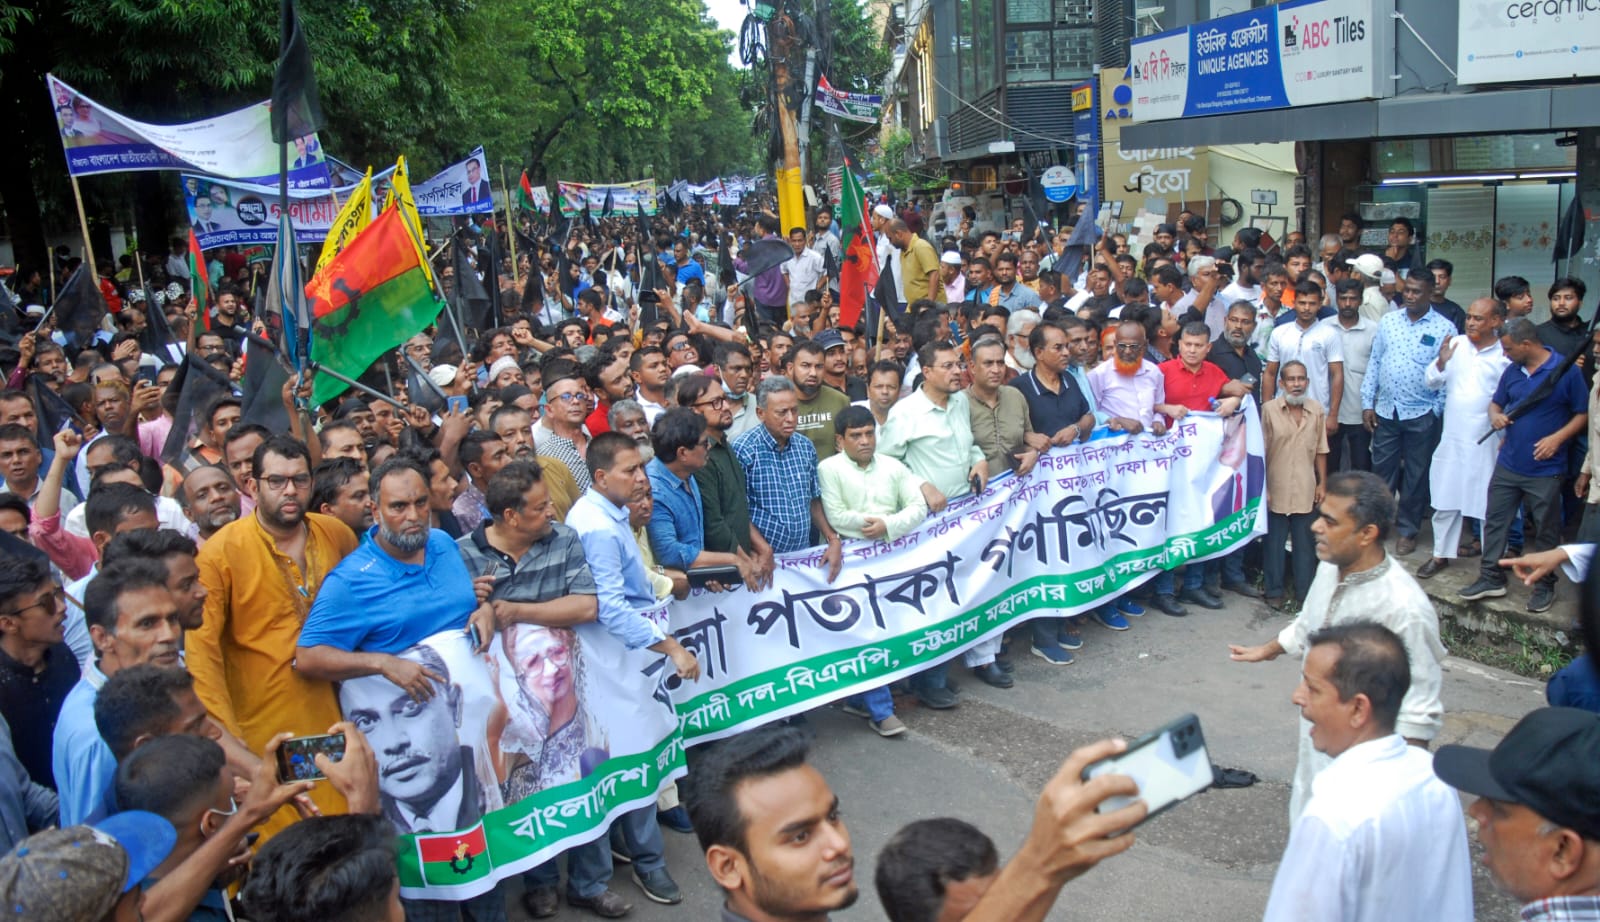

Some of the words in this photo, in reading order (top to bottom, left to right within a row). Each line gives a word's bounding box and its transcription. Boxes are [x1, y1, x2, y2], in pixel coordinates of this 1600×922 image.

[1196, 28, 1228, 57] ইউনিক
[1302, 20, 1330, 50] ABC
[1334, 16, 1365, 44] Tiles
[1198, 56, 1226, 76] UNIQUE
[1227, 48, 1269, 71] AGENCIES
[1104, 107, 1132, 119] AS
[927, 515, 964, 538] গঠন
[966, 502, 1006, 525] করে
[1114, 459, 1147, 478] দফা
[747, 550, 963, 650] পতাকা
[981, 487, 1171, 579] গণমিছিল
[508, 762, 651, 841] বাংলাদেশ
[736, 647, 900, 709] দল-বিএনপি,
[909, 615, 981, 657] চট্টগ্রাম
[985, 582, 1067, 624] মহানগর
